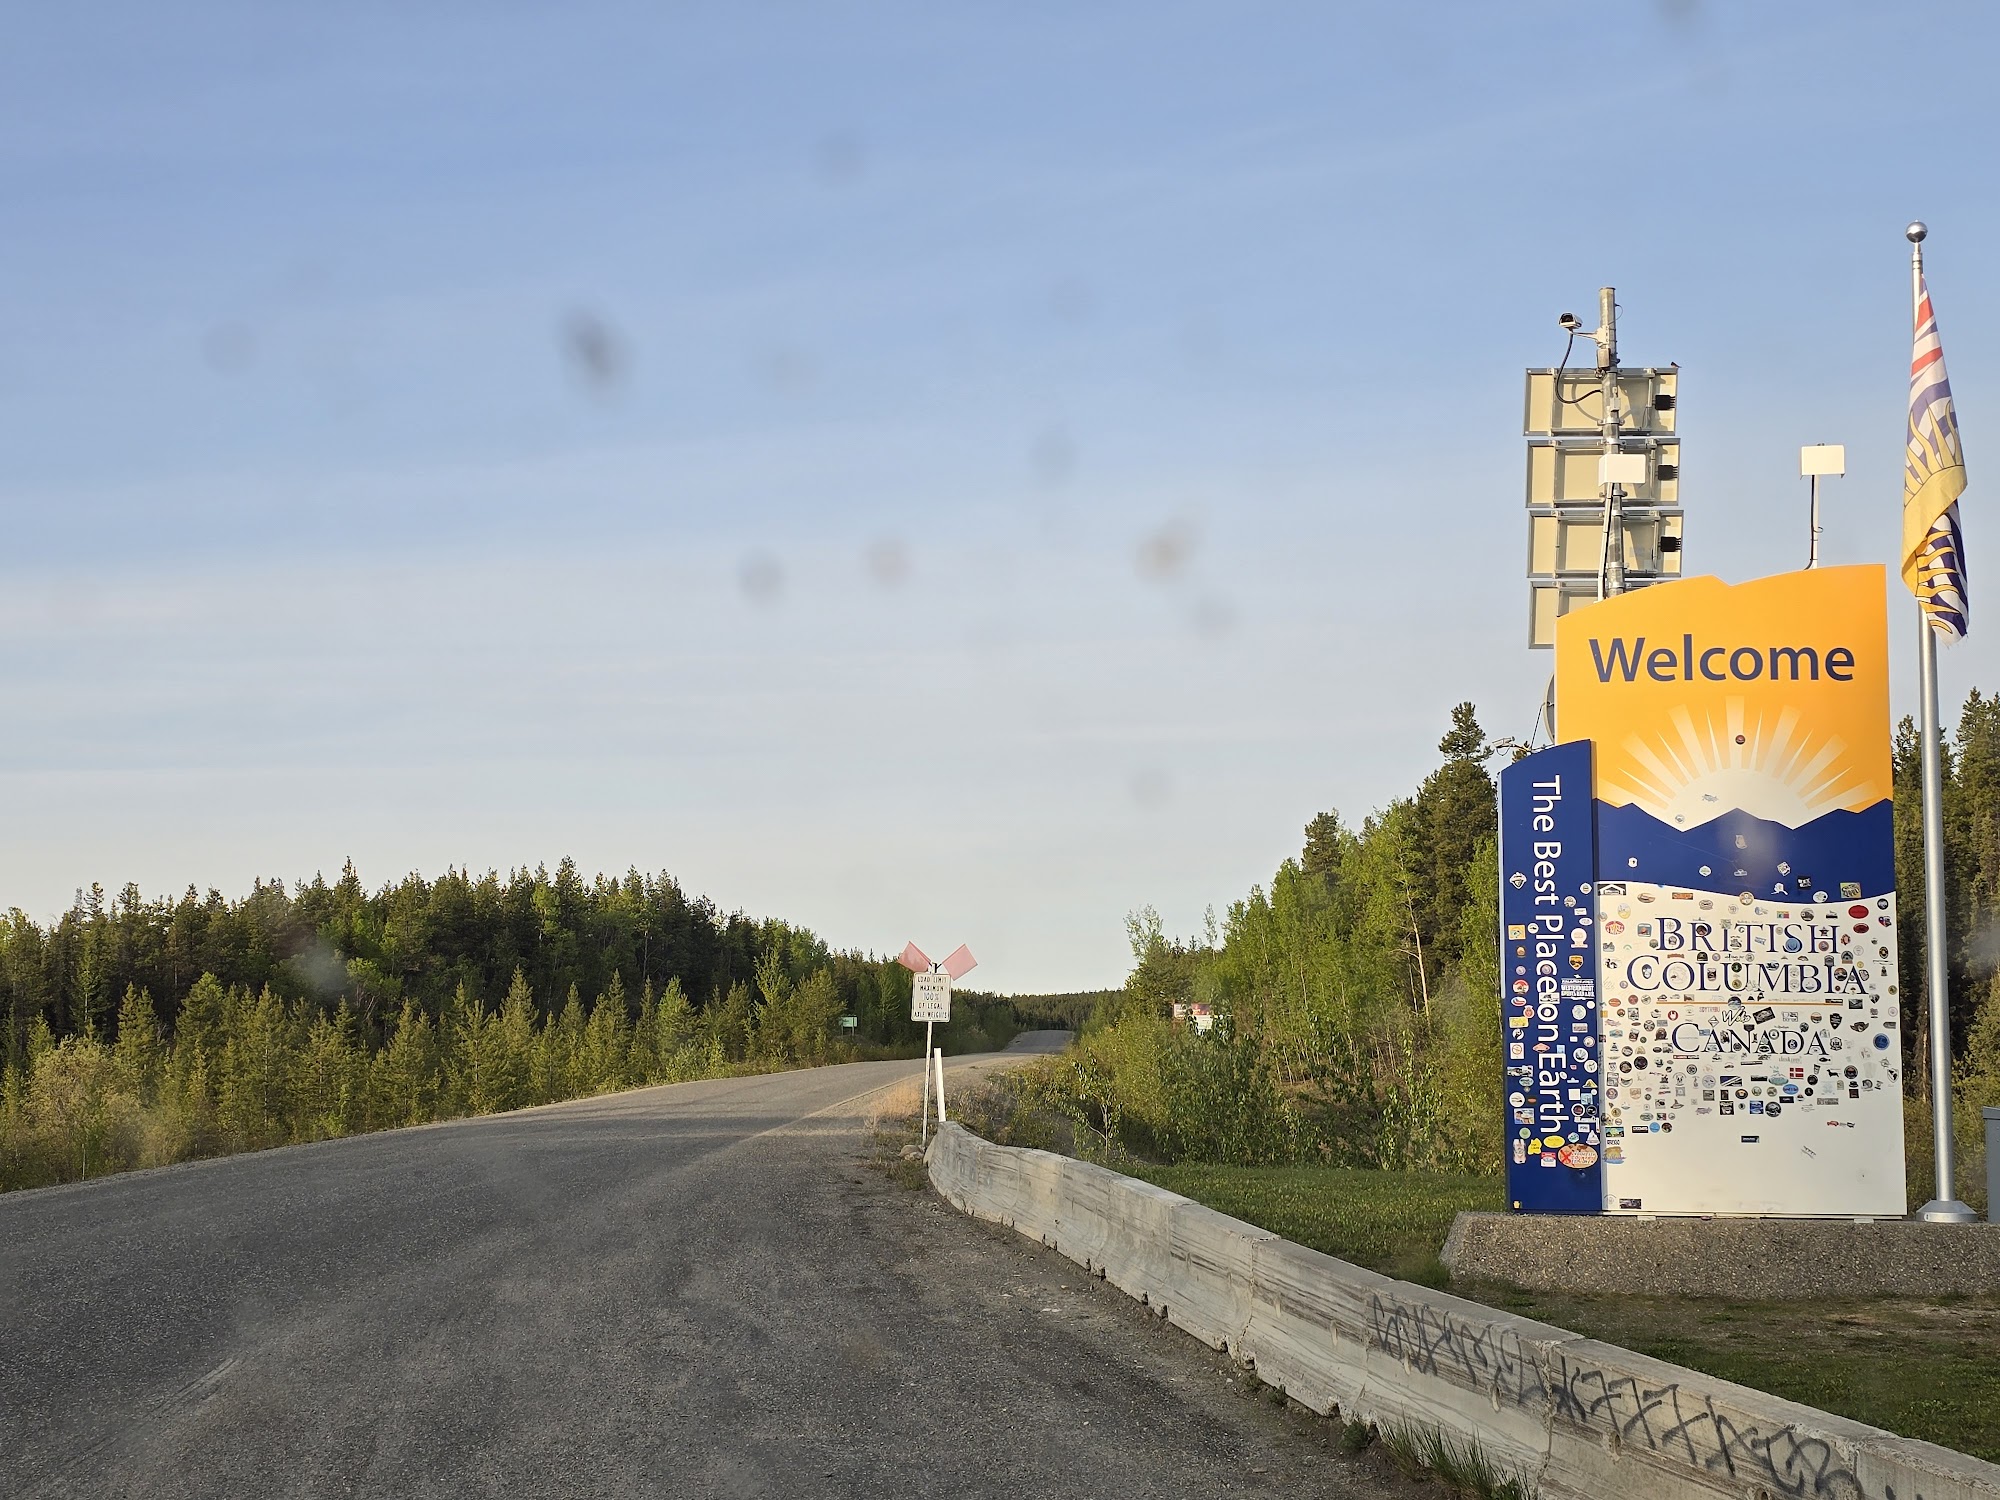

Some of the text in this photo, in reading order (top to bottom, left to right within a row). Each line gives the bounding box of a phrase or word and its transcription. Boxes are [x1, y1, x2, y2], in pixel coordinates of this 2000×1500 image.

[1588, 633, 1855, 683] Welcome
[1532, 774, 1562, 832] The
[1533, 841, 1563, 906] Best
[1535, 914, 1565, 995] Place
[1654, 916, 1841, 954] BRITISH
[1626, 954, 1869, 995] COLUMBIA
[1537, 1003, 1559, 1042] on
[1671, 1022, 1830, 1056] CANADA
[1538, 1053, 1570, 1133] Earth
